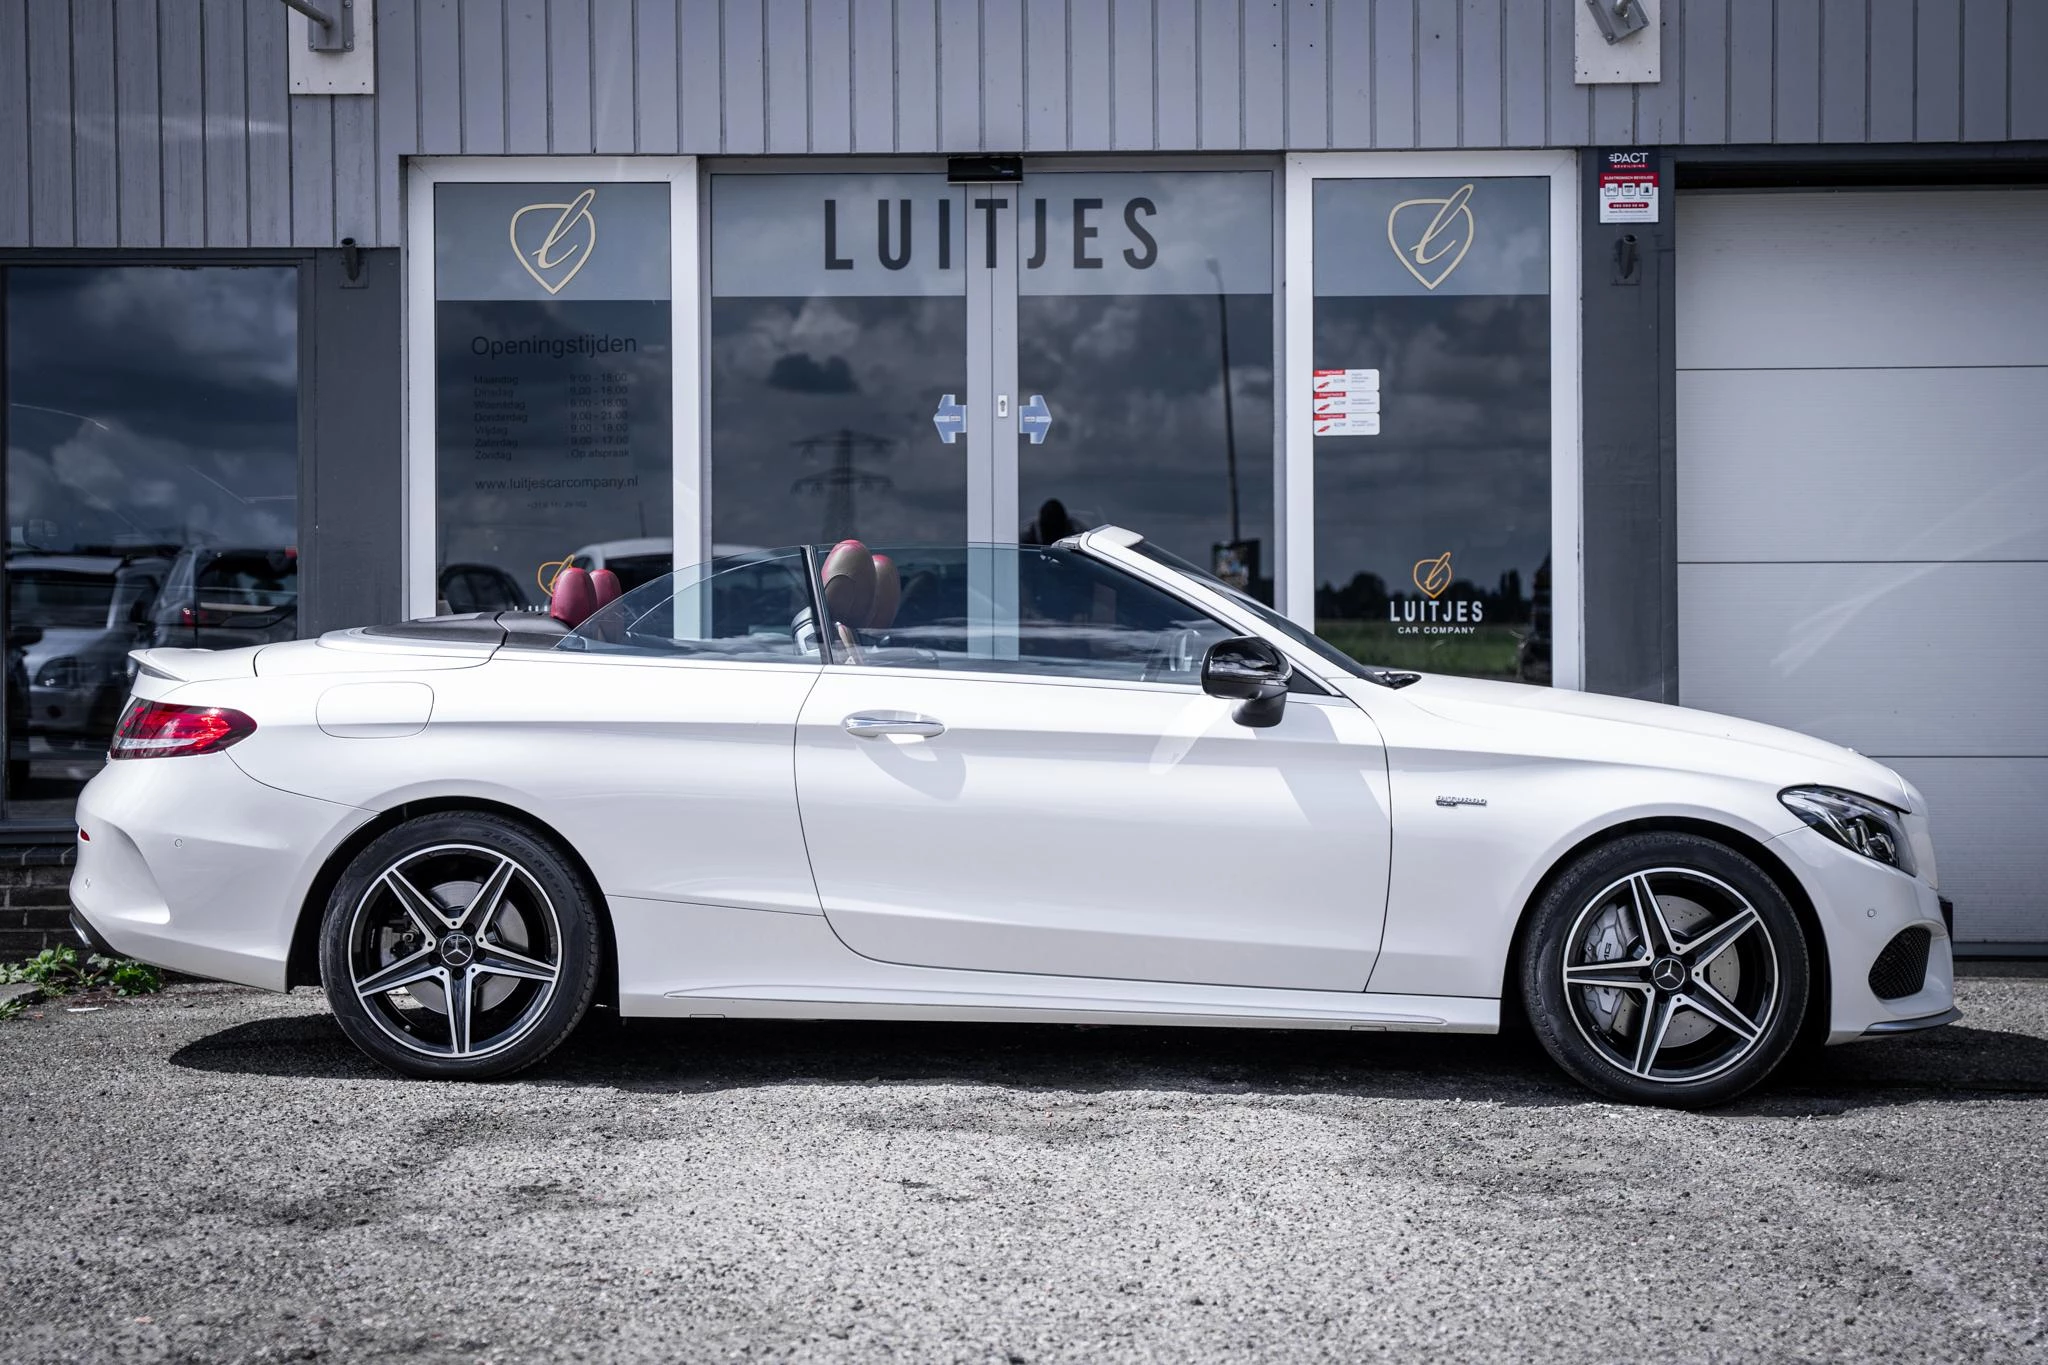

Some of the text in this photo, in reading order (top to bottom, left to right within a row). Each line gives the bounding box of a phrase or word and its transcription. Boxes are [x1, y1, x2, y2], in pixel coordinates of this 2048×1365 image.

[1612, 152, 1649, 163] PACT
[824, 197, 1158, 271] LUITJES
[471, 335, 637, 359] Openingstijden
[475, 476, 638, 491] www.luitjescarcompany.nl
[1390, 601, 1483, 622] LUITJES
[1423, 626, 1475, 634] COMPANY
